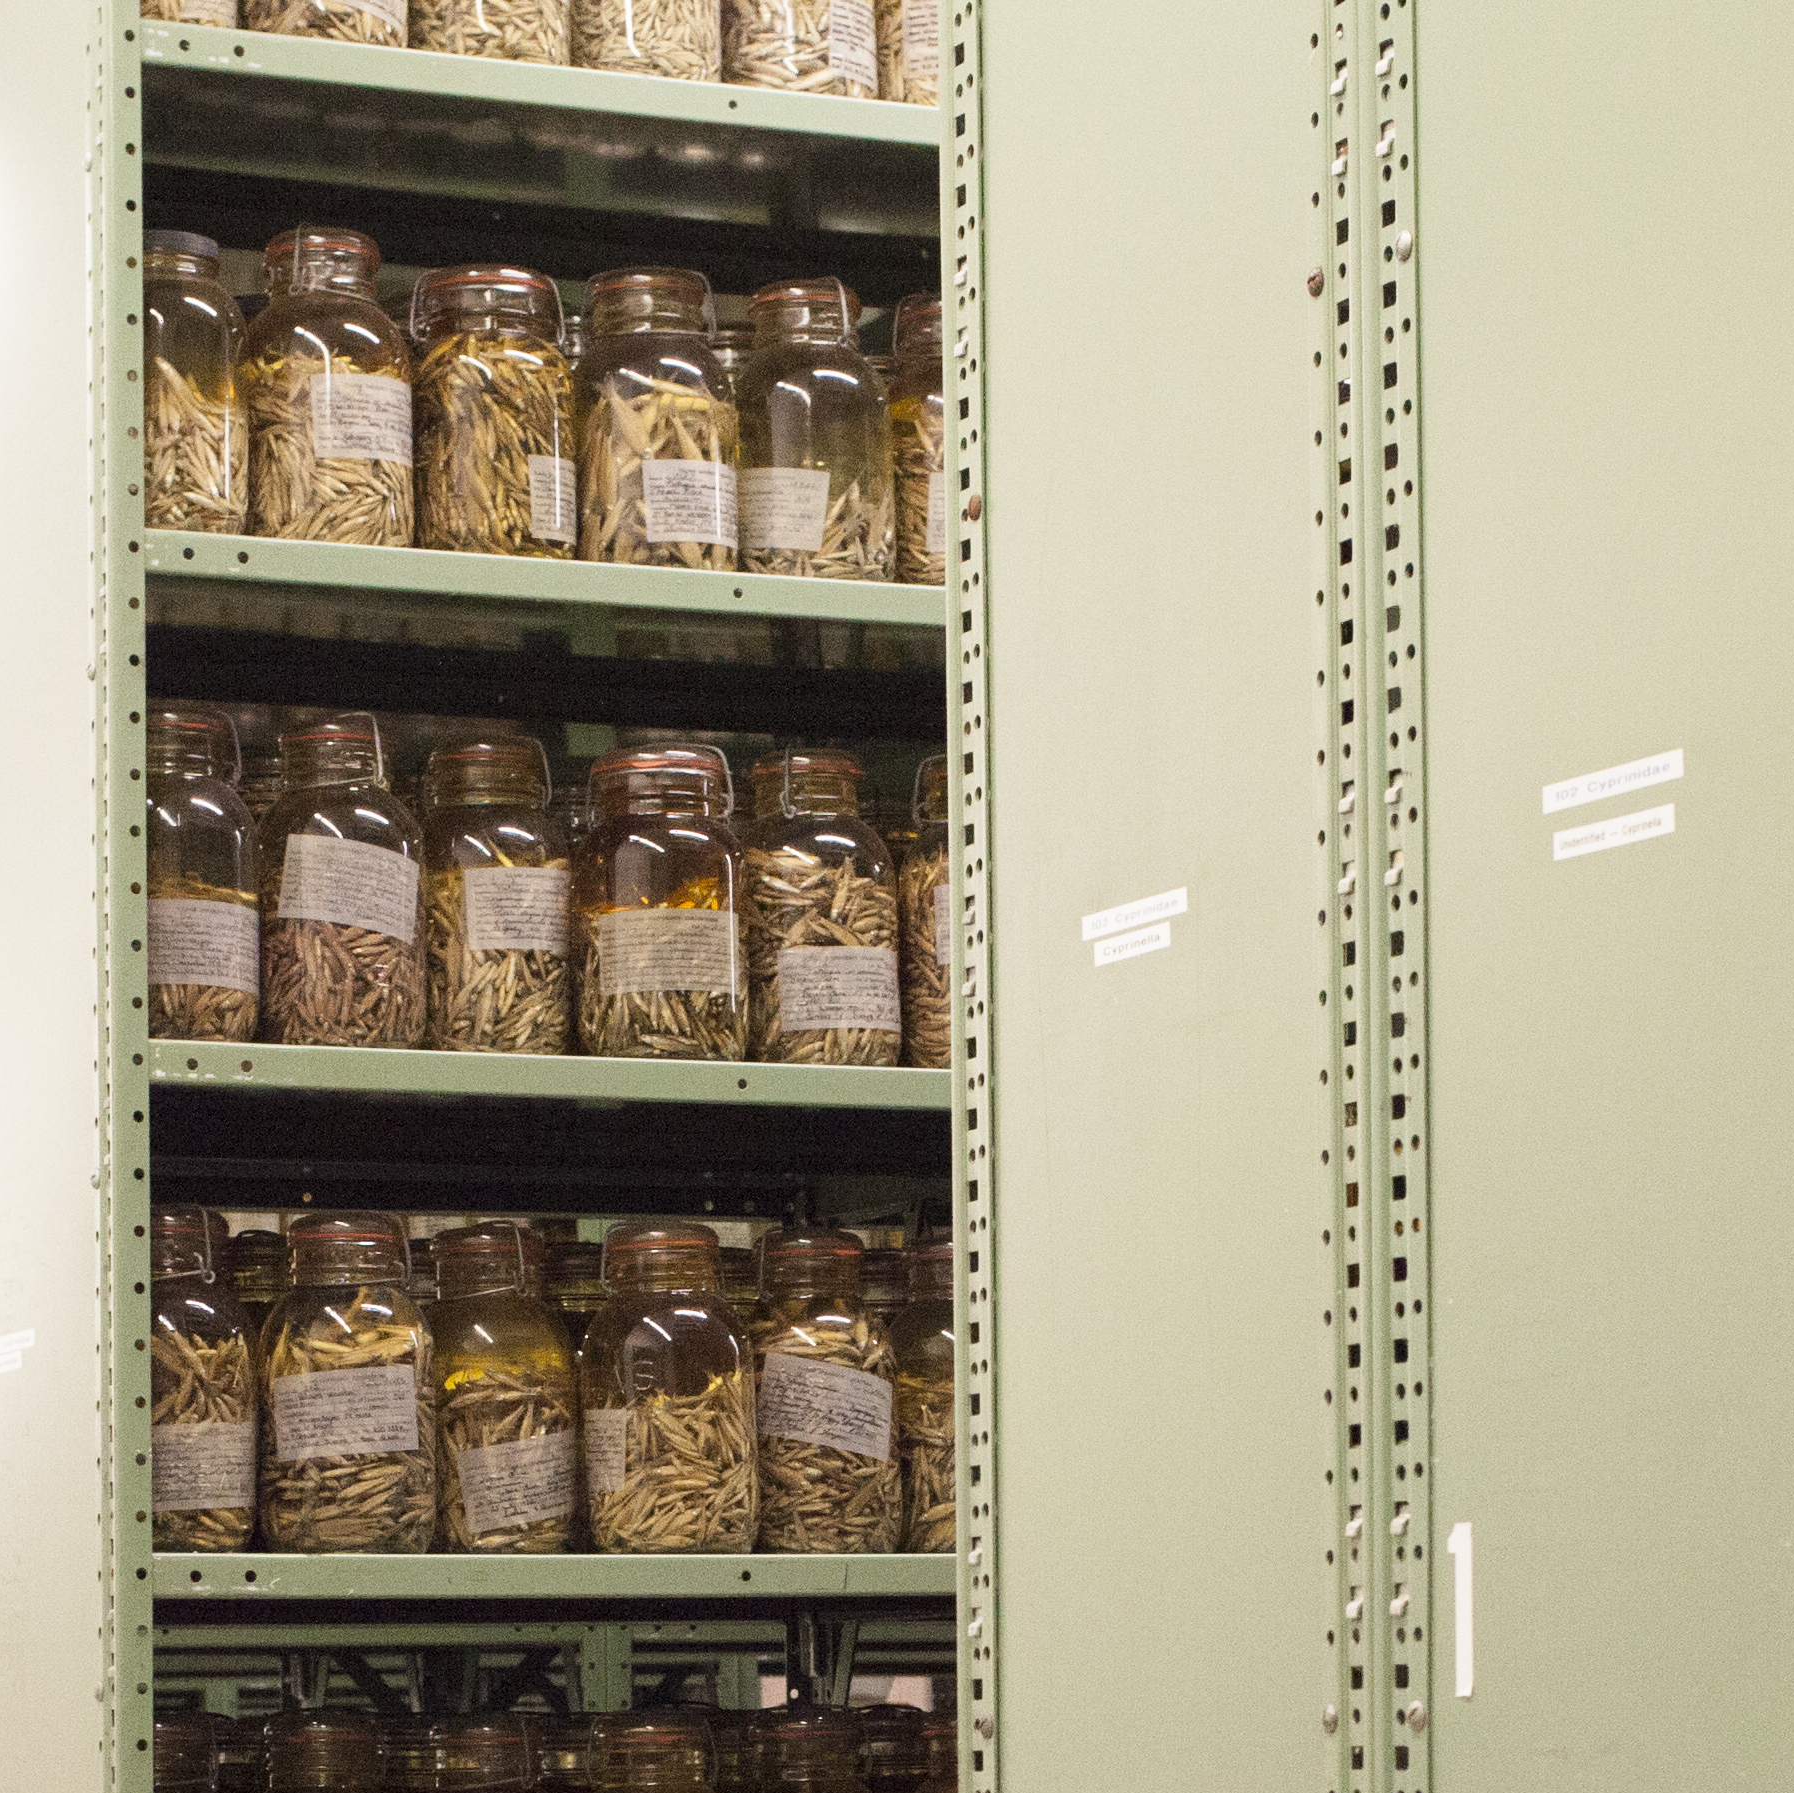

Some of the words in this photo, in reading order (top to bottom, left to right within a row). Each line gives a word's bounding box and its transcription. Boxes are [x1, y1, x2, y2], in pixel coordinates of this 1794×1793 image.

[1555, 786, 1579, 802] 102
[1586, 762, 1671, 793] Cyprinidae
[1559, 830, 1606, 851] Unidentified
[1621, 816, 1662, 836] Cyprinella
[1091, 917, 1109, 931] 102
[1115, 898, 1179, 923] Cyprinidae
[1103, 933, 1161, 957] Cyprinella
[1447, 1522, 1474, 1697] 1
